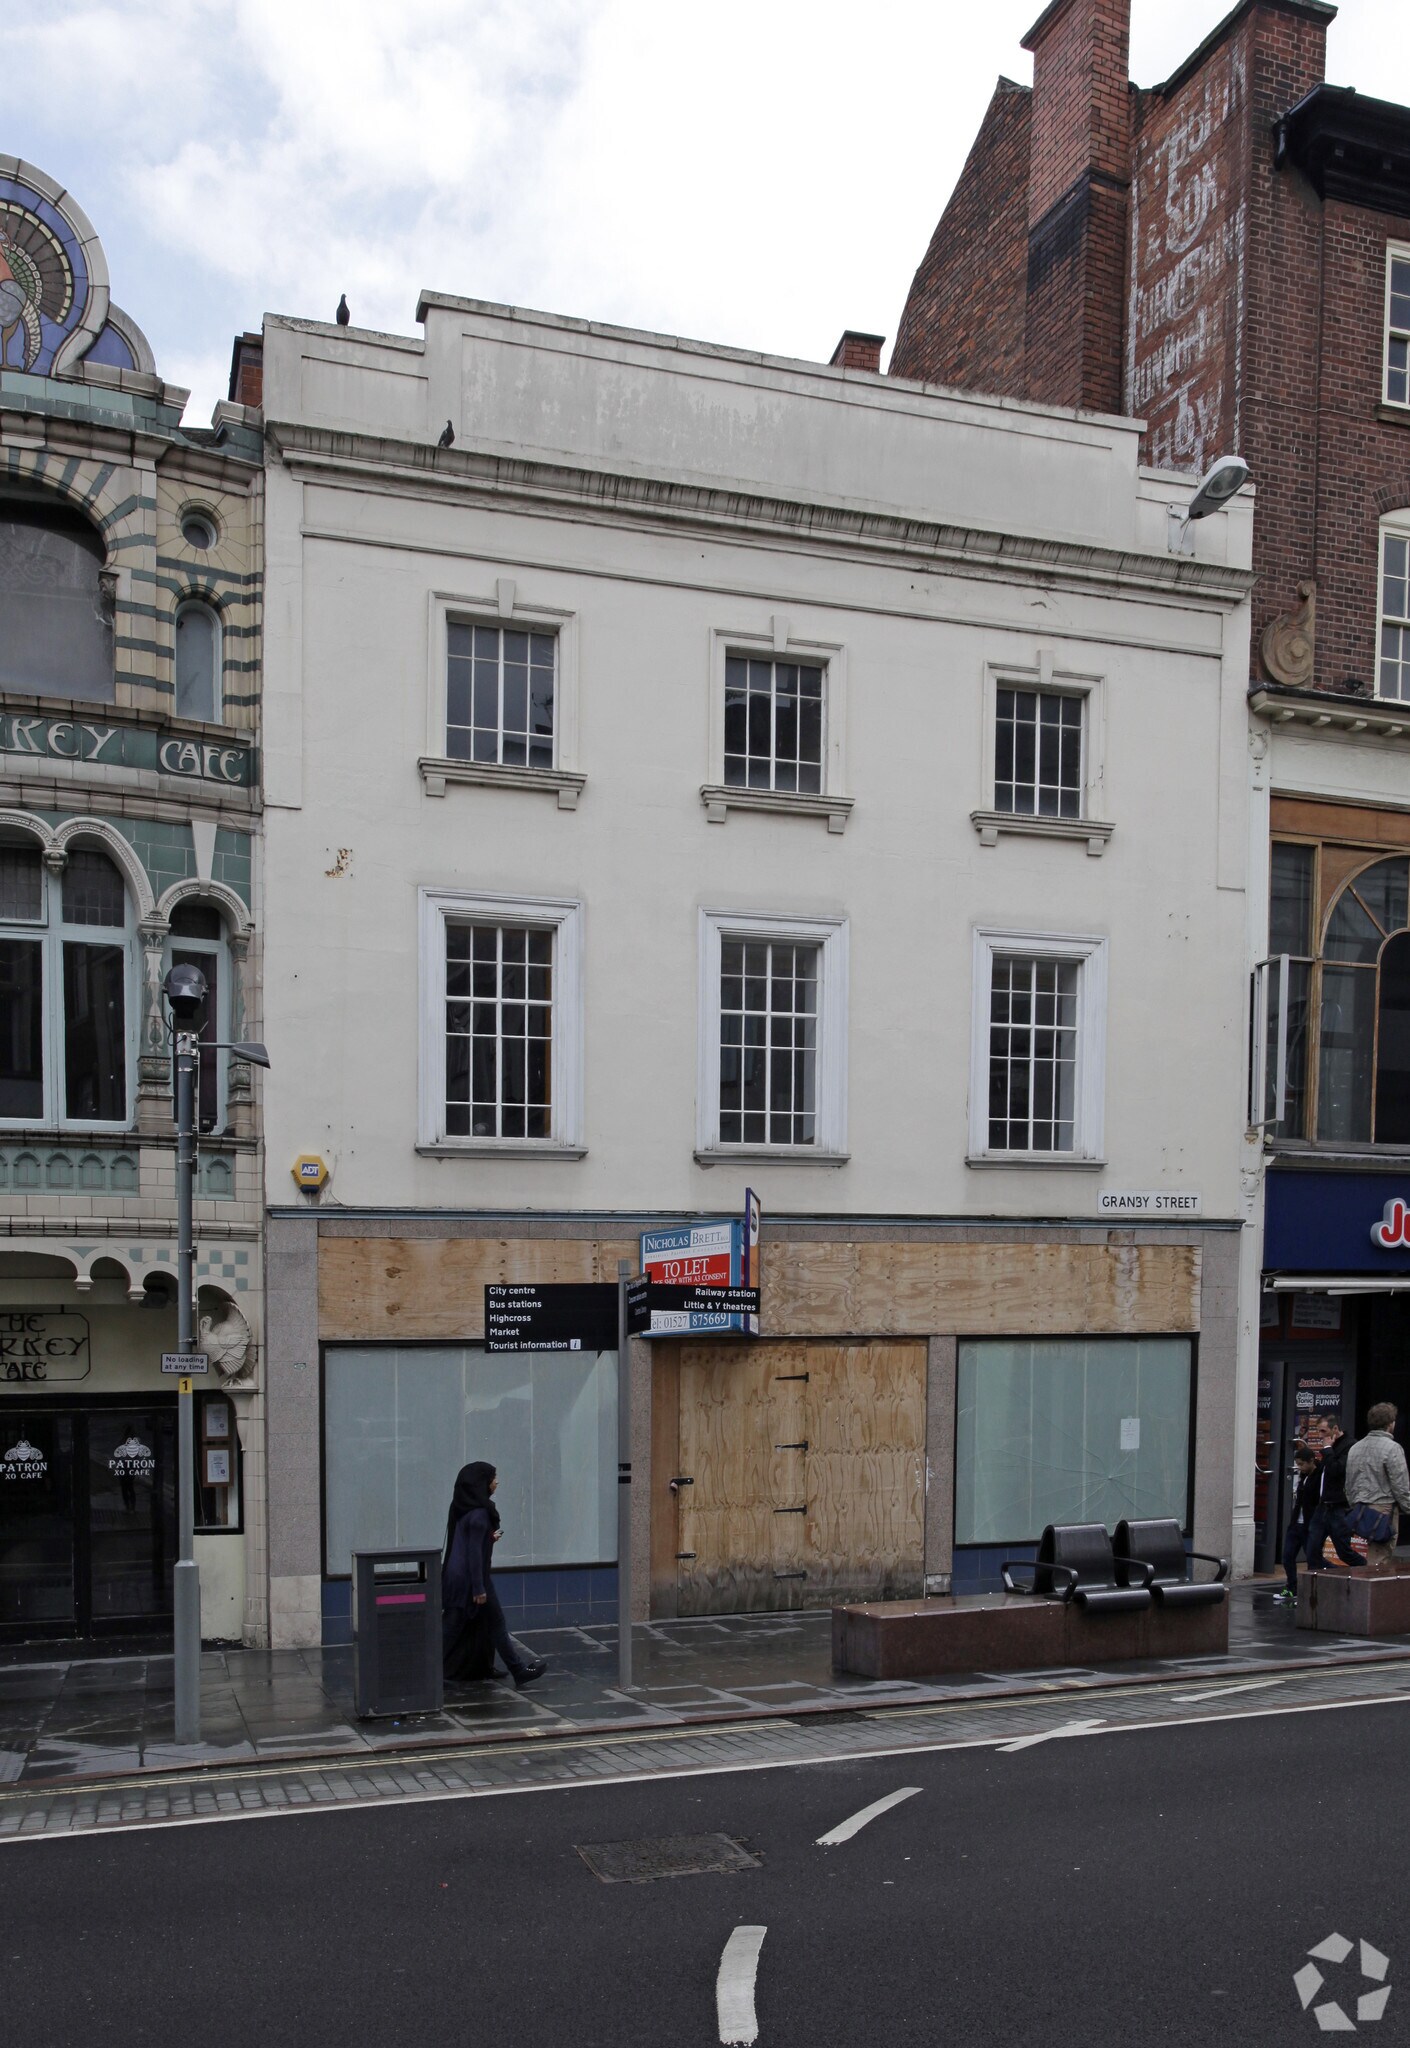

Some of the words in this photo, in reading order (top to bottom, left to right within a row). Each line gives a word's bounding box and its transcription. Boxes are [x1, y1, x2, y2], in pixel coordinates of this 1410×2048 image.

[0, 716, 117, 760] KEY
[301, 1166, 319, 1175] ADT
[1155, 1196, 1198, 1209] STREET
[647, 1235, 688, 1250] NICHOLAS
[692, 1232, 721, 1245] BRETT
[662, 1261, 680, 1278] TO
[684, 1258, 709, 1276] LET
[701, 1272, 727, 1281] CONSENT
[489, 1286, 507, 1296] City
[508, 1286, 536, 1294] centre
[695, 1287, 726, 1298] Railway
[728, 1289, 756, 1298] station
[684, 1301, 705, 1309] Little
[706, 1301, 713, 1309] &
[715, 1302, 721, 1310] Y
[722, 1302, 756, 1311] theatres
[489, 1314, 532, 1323] Highcross
[651, 1317, 662, 1329] el:
[663, 1315, 688, 1329] 01527
[692, 1312, 727, 1327] 875669
[489, 1328, 519, 1336] Market
[489, 1341, 518, 1349] Tourist
[520, 1341, 568, 1349] information
[178, 1356, 204, 1364] loading
[182, 1380, 188, 1391] 1
